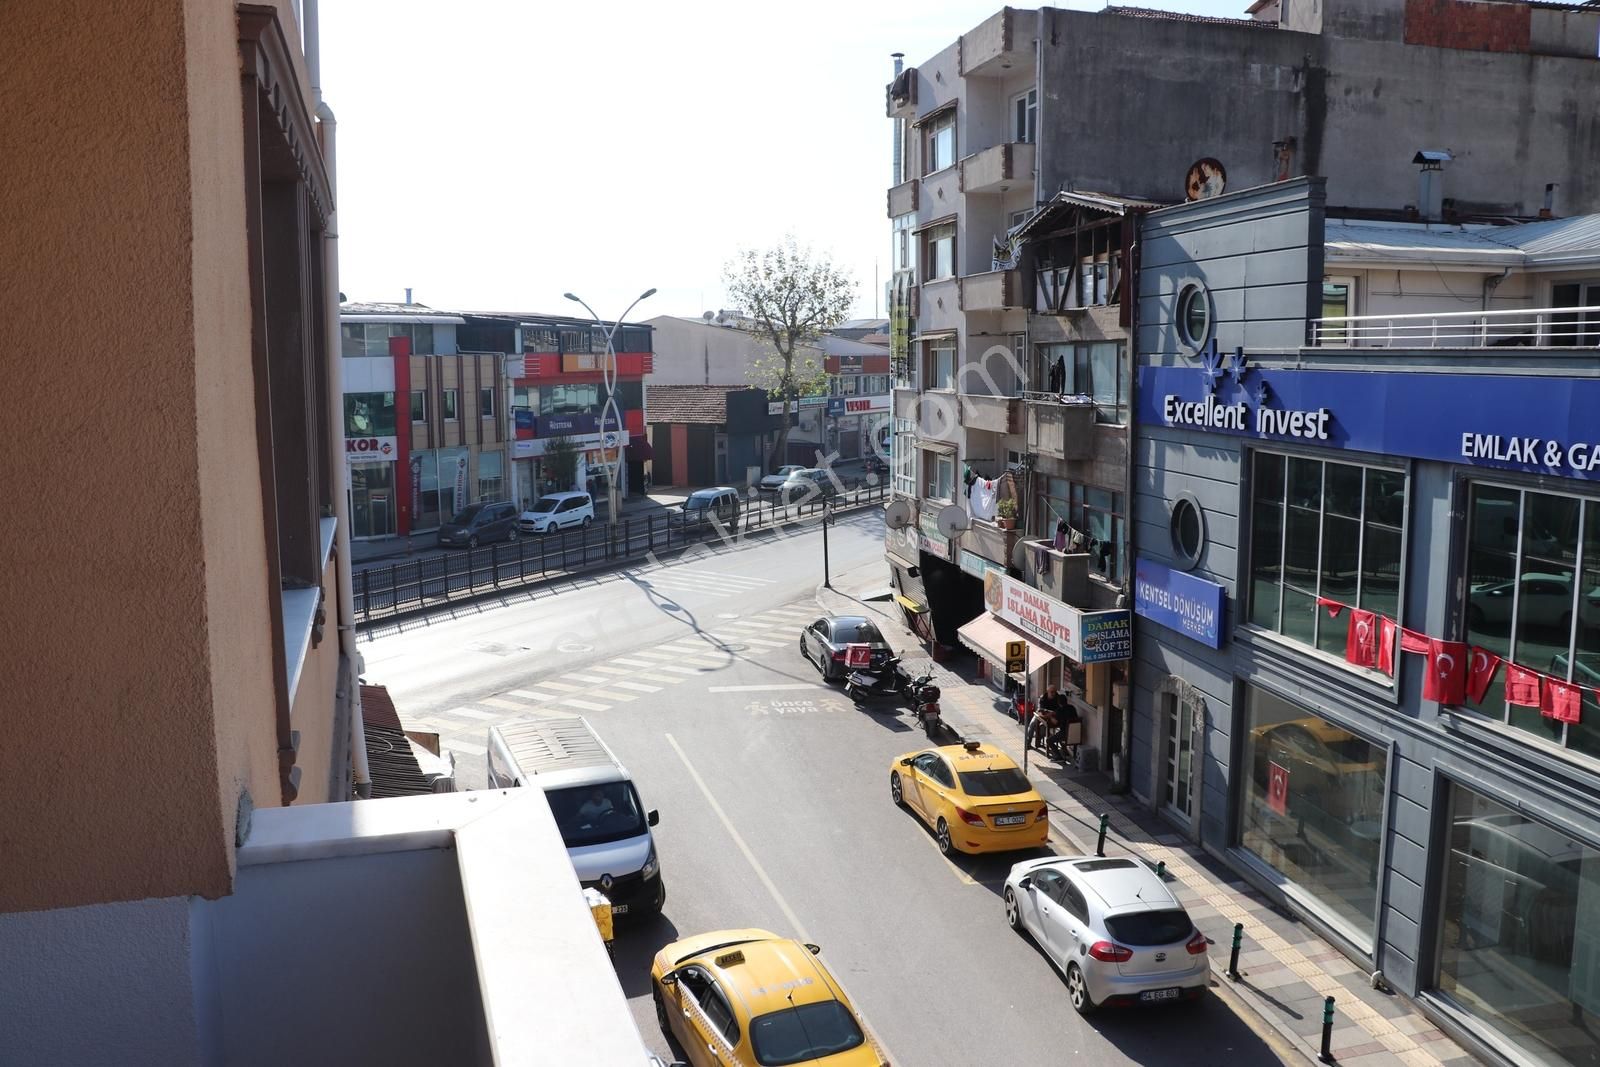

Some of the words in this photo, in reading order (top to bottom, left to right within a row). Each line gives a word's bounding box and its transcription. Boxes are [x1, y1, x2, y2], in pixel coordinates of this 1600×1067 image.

[1163, 394, 1246, 431] Excellent
[1256, 408, 1329, 440] invest
[346, 439, 379, 452] KOR
[1461, 432, 1540, 465] EMLAK
[1543, 440, 1562, 467] &
[1023, 591, 1050, 613] DAMAK
[1140, 582, 1172, 611] KENTSEL
[1040, 615, 1071, 642] KÖFTE
[1088, 619, 1128, 631] DAMAK
[1011, 643, 1021, 657] D
[774, 706, 818, 715] yaya
